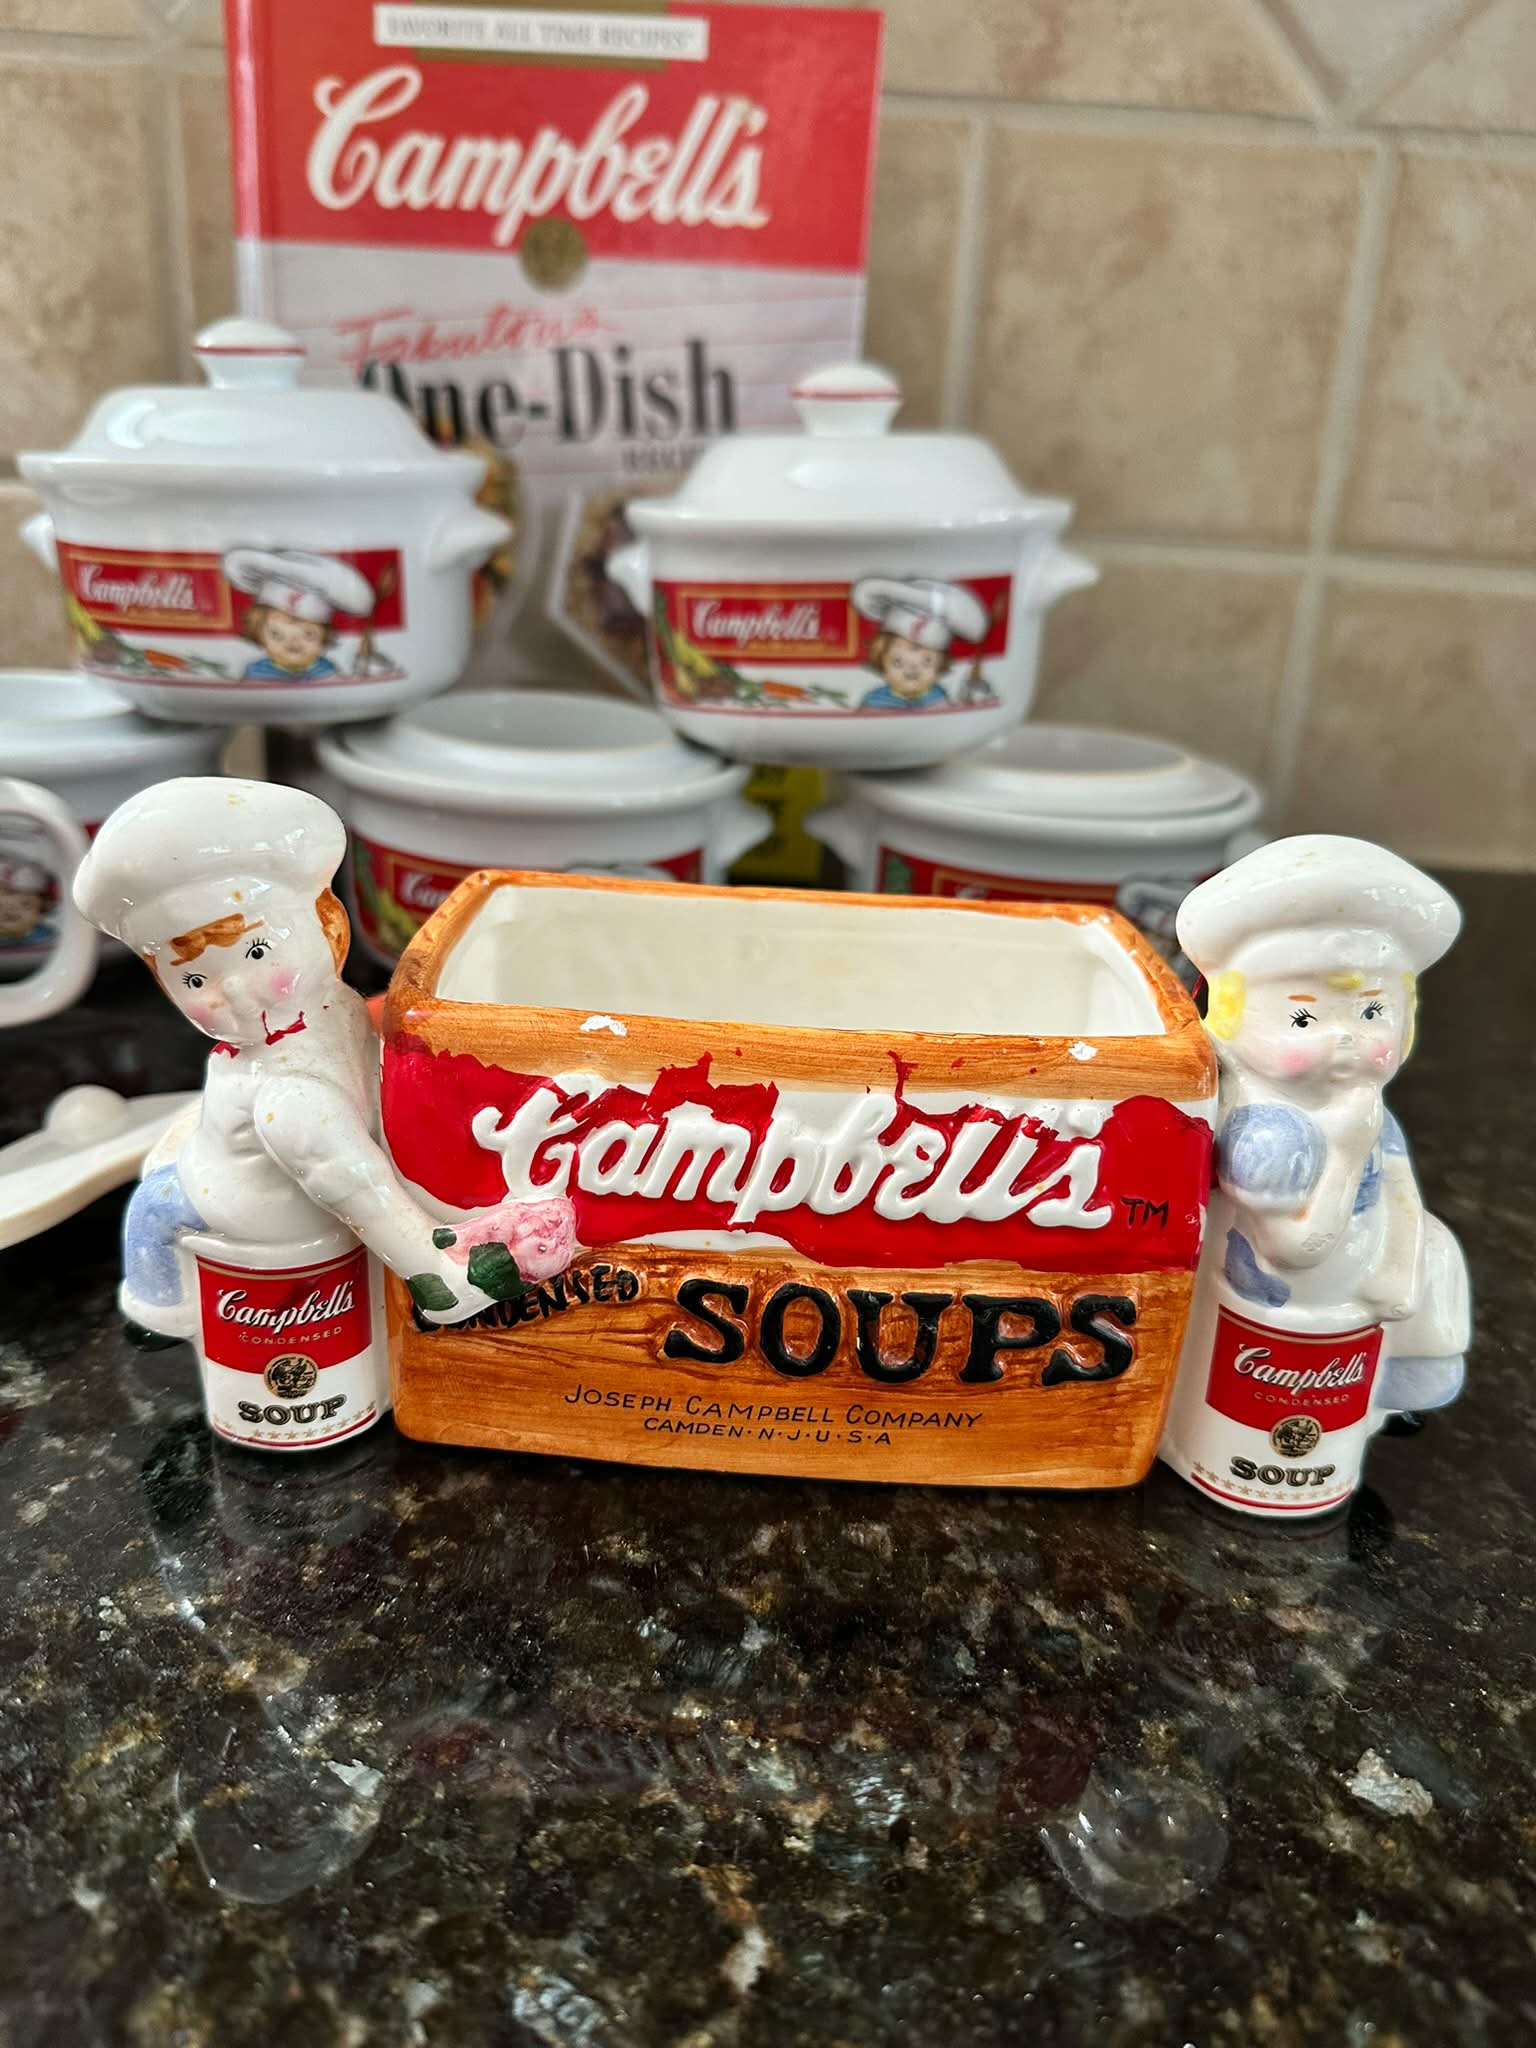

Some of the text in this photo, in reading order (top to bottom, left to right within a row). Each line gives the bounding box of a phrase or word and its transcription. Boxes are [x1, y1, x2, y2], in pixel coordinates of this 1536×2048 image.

[307, 65, 768, 246] Campbell's
[1122, 1196, 1170, 1230] TM
[217, 1280, 355, 1335] Campbell's
[239, 1326, 343, 1346] CONDENSED
[664, 1277, 1138, 1386] SOUPS
[1233, 1343, 1368, 1396] Campbell's
[238, 1394, 347, 1426] SOUP
[564, 1383, 983, 1428] JOSEPH CAMPBELL COMPANY
[1253, 1391, 1350, 1406] CONDENSED
[1229, 1455, 1336, 1487] SOUP
